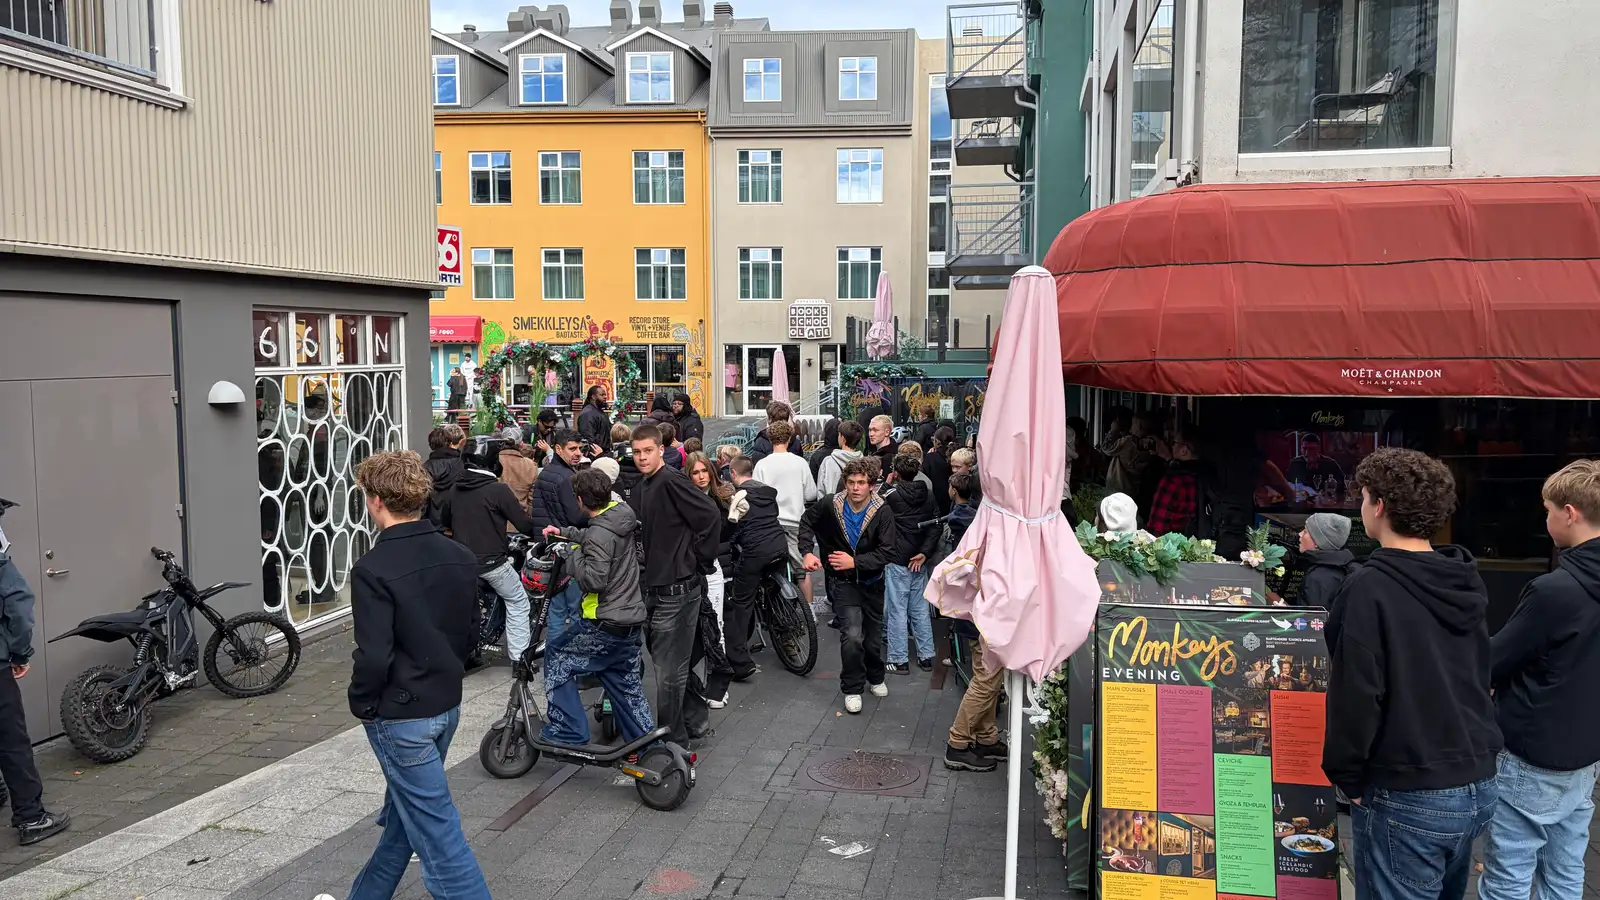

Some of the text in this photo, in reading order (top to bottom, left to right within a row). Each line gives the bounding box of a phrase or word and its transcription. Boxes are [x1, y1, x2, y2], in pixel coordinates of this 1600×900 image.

[438, 233, 458, 268] 6°
[513, 316, 587, 330] SMEKKLEYSA
[790, 328, 829, 337] OLATE
[1341, 368, 1373, 378] MOËT
[1384, 369, 1442, 378] CHANDON
[1311, 410, 1344, 426] Monkeys
[1108, 616, 1237, 680] Monkeys
[1102, 667, 1181, 681] EVENING
